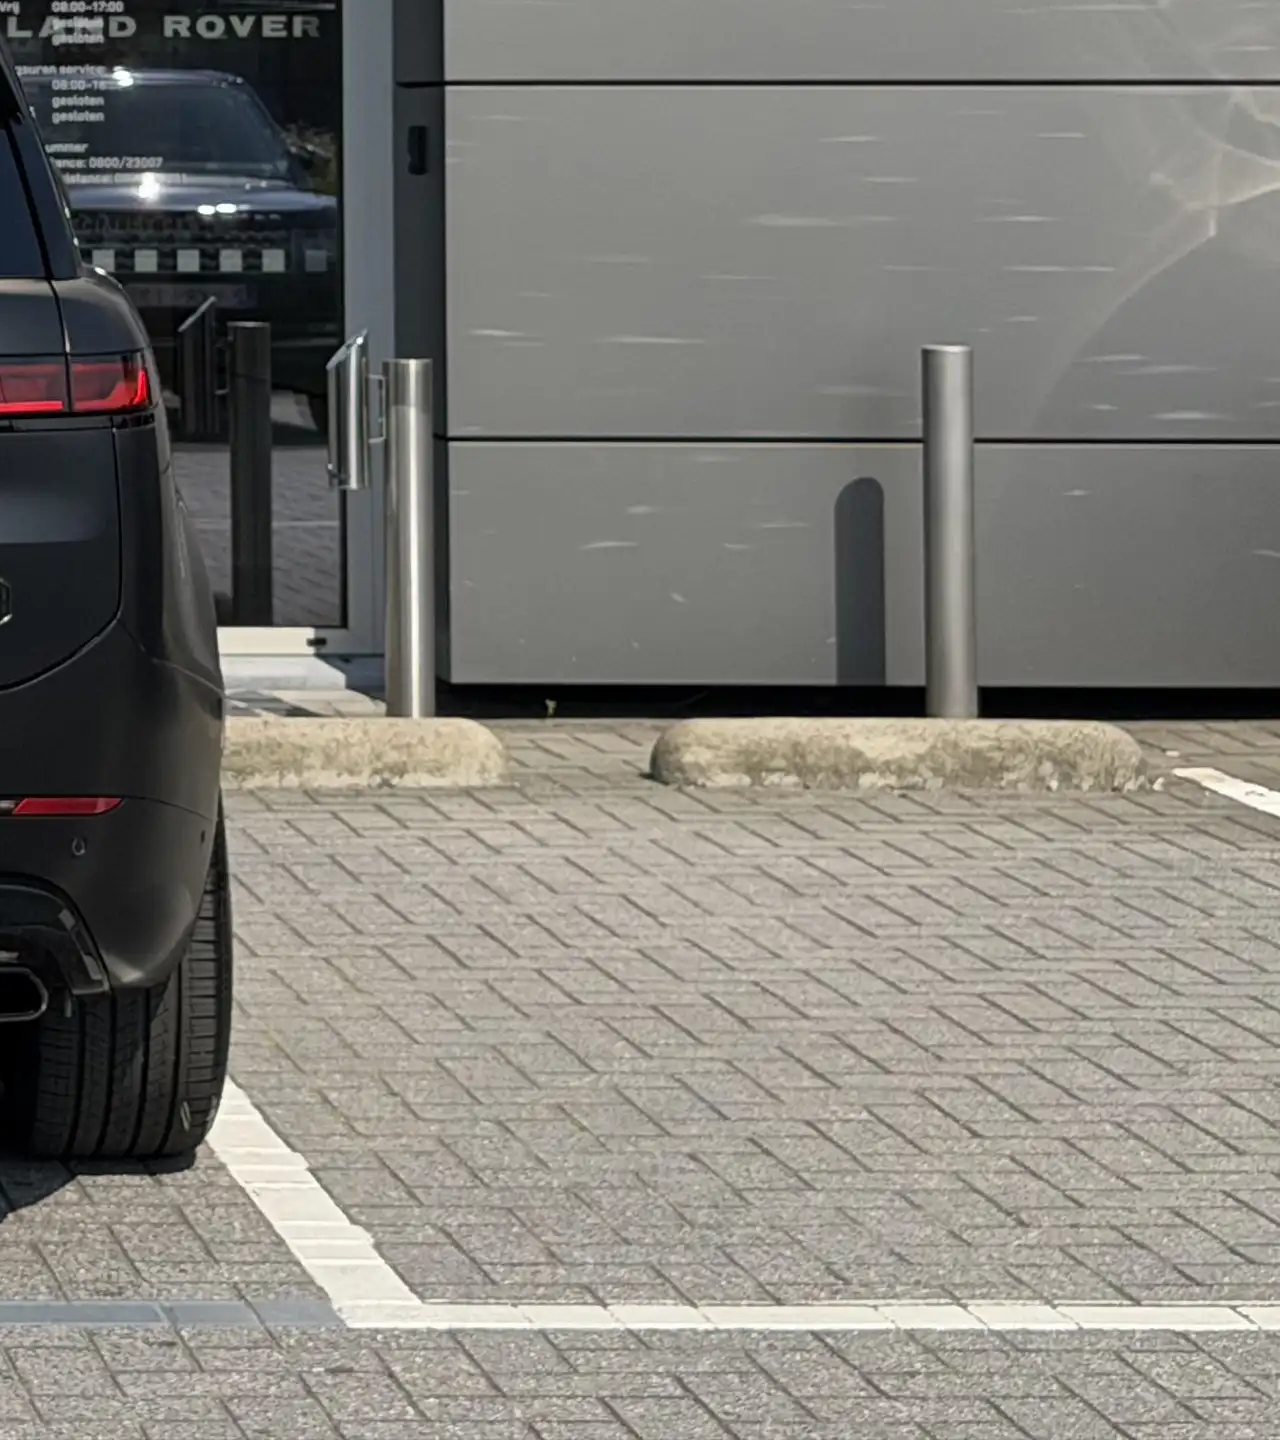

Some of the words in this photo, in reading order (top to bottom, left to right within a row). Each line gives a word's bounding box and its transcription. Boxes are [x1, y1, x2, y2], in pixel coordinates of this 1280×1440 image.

[163, 16, 320, 38] ROVER
[51, 93, 105, 108] gesloten
[51, 109, 105, 124] gesloten
